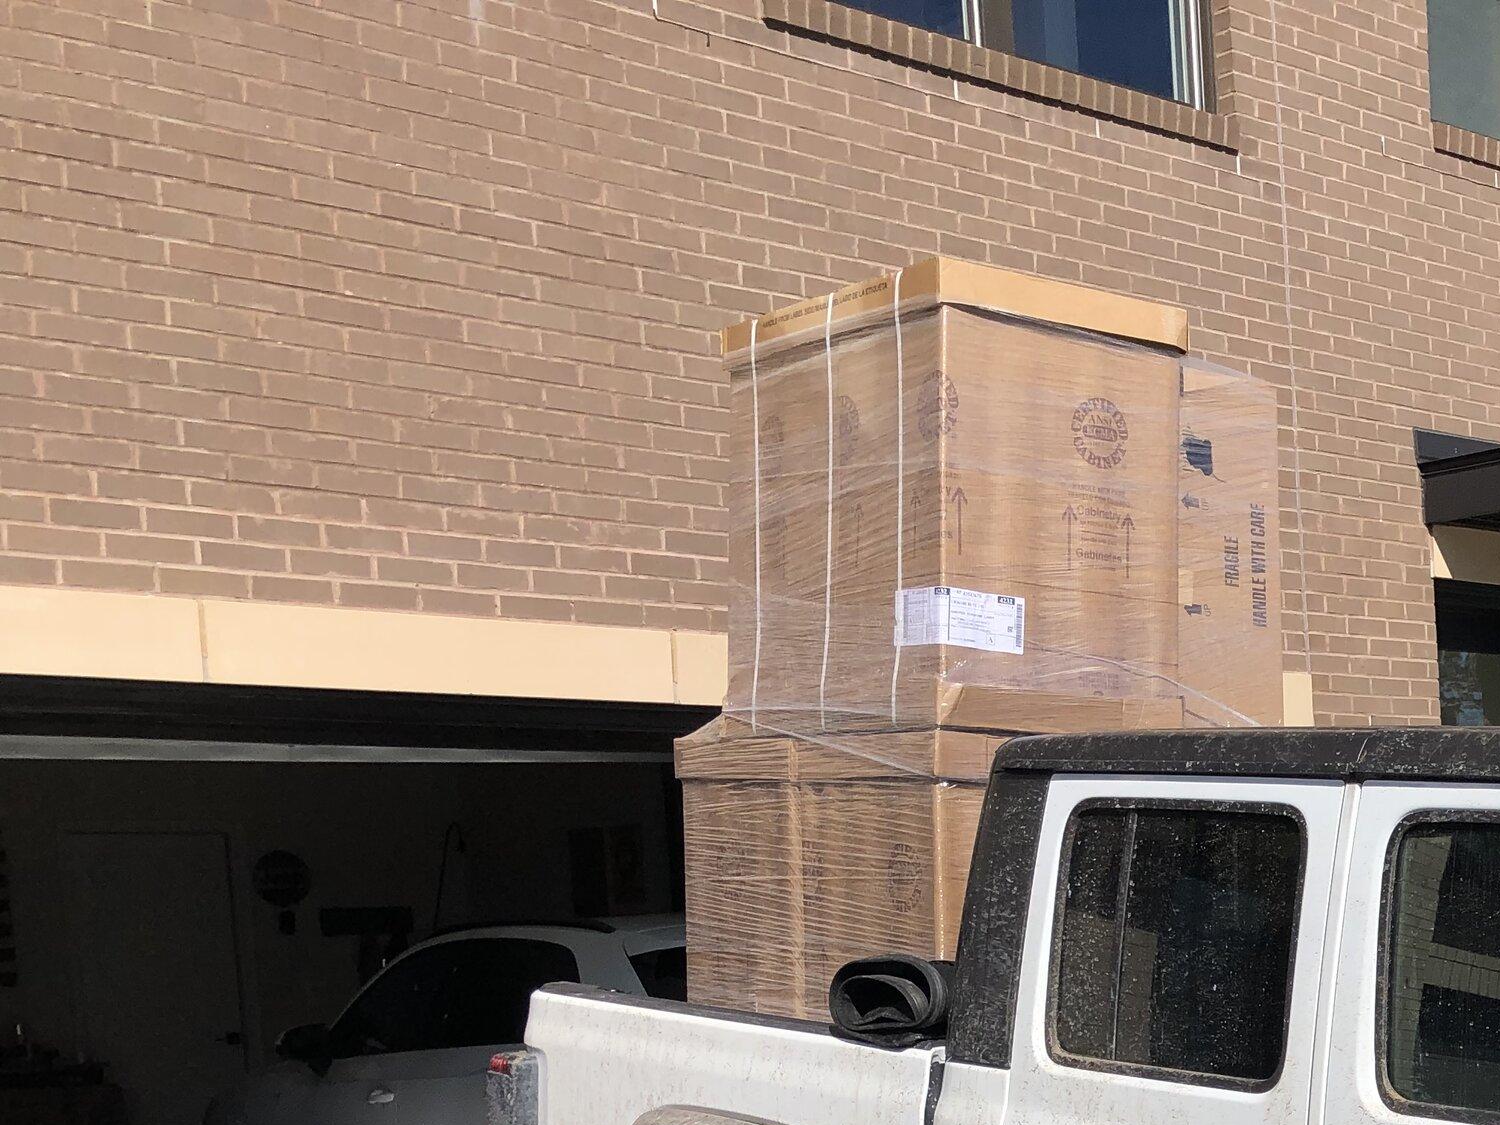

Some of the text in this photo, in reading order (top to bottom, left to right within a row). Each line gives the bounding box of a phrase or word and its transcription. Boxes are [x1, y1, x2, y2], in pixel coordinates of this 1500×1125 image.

[1071, 397, 1129, 440] CERTIFIED
[1073, 436, 1127, 469] CABINET
[1077, 504, 1122, 524] Cabinetry
[1223, 536, 1240, 588] FRAGILE
[1250, 503, 1267, 628] HANDLE WITH CARE
